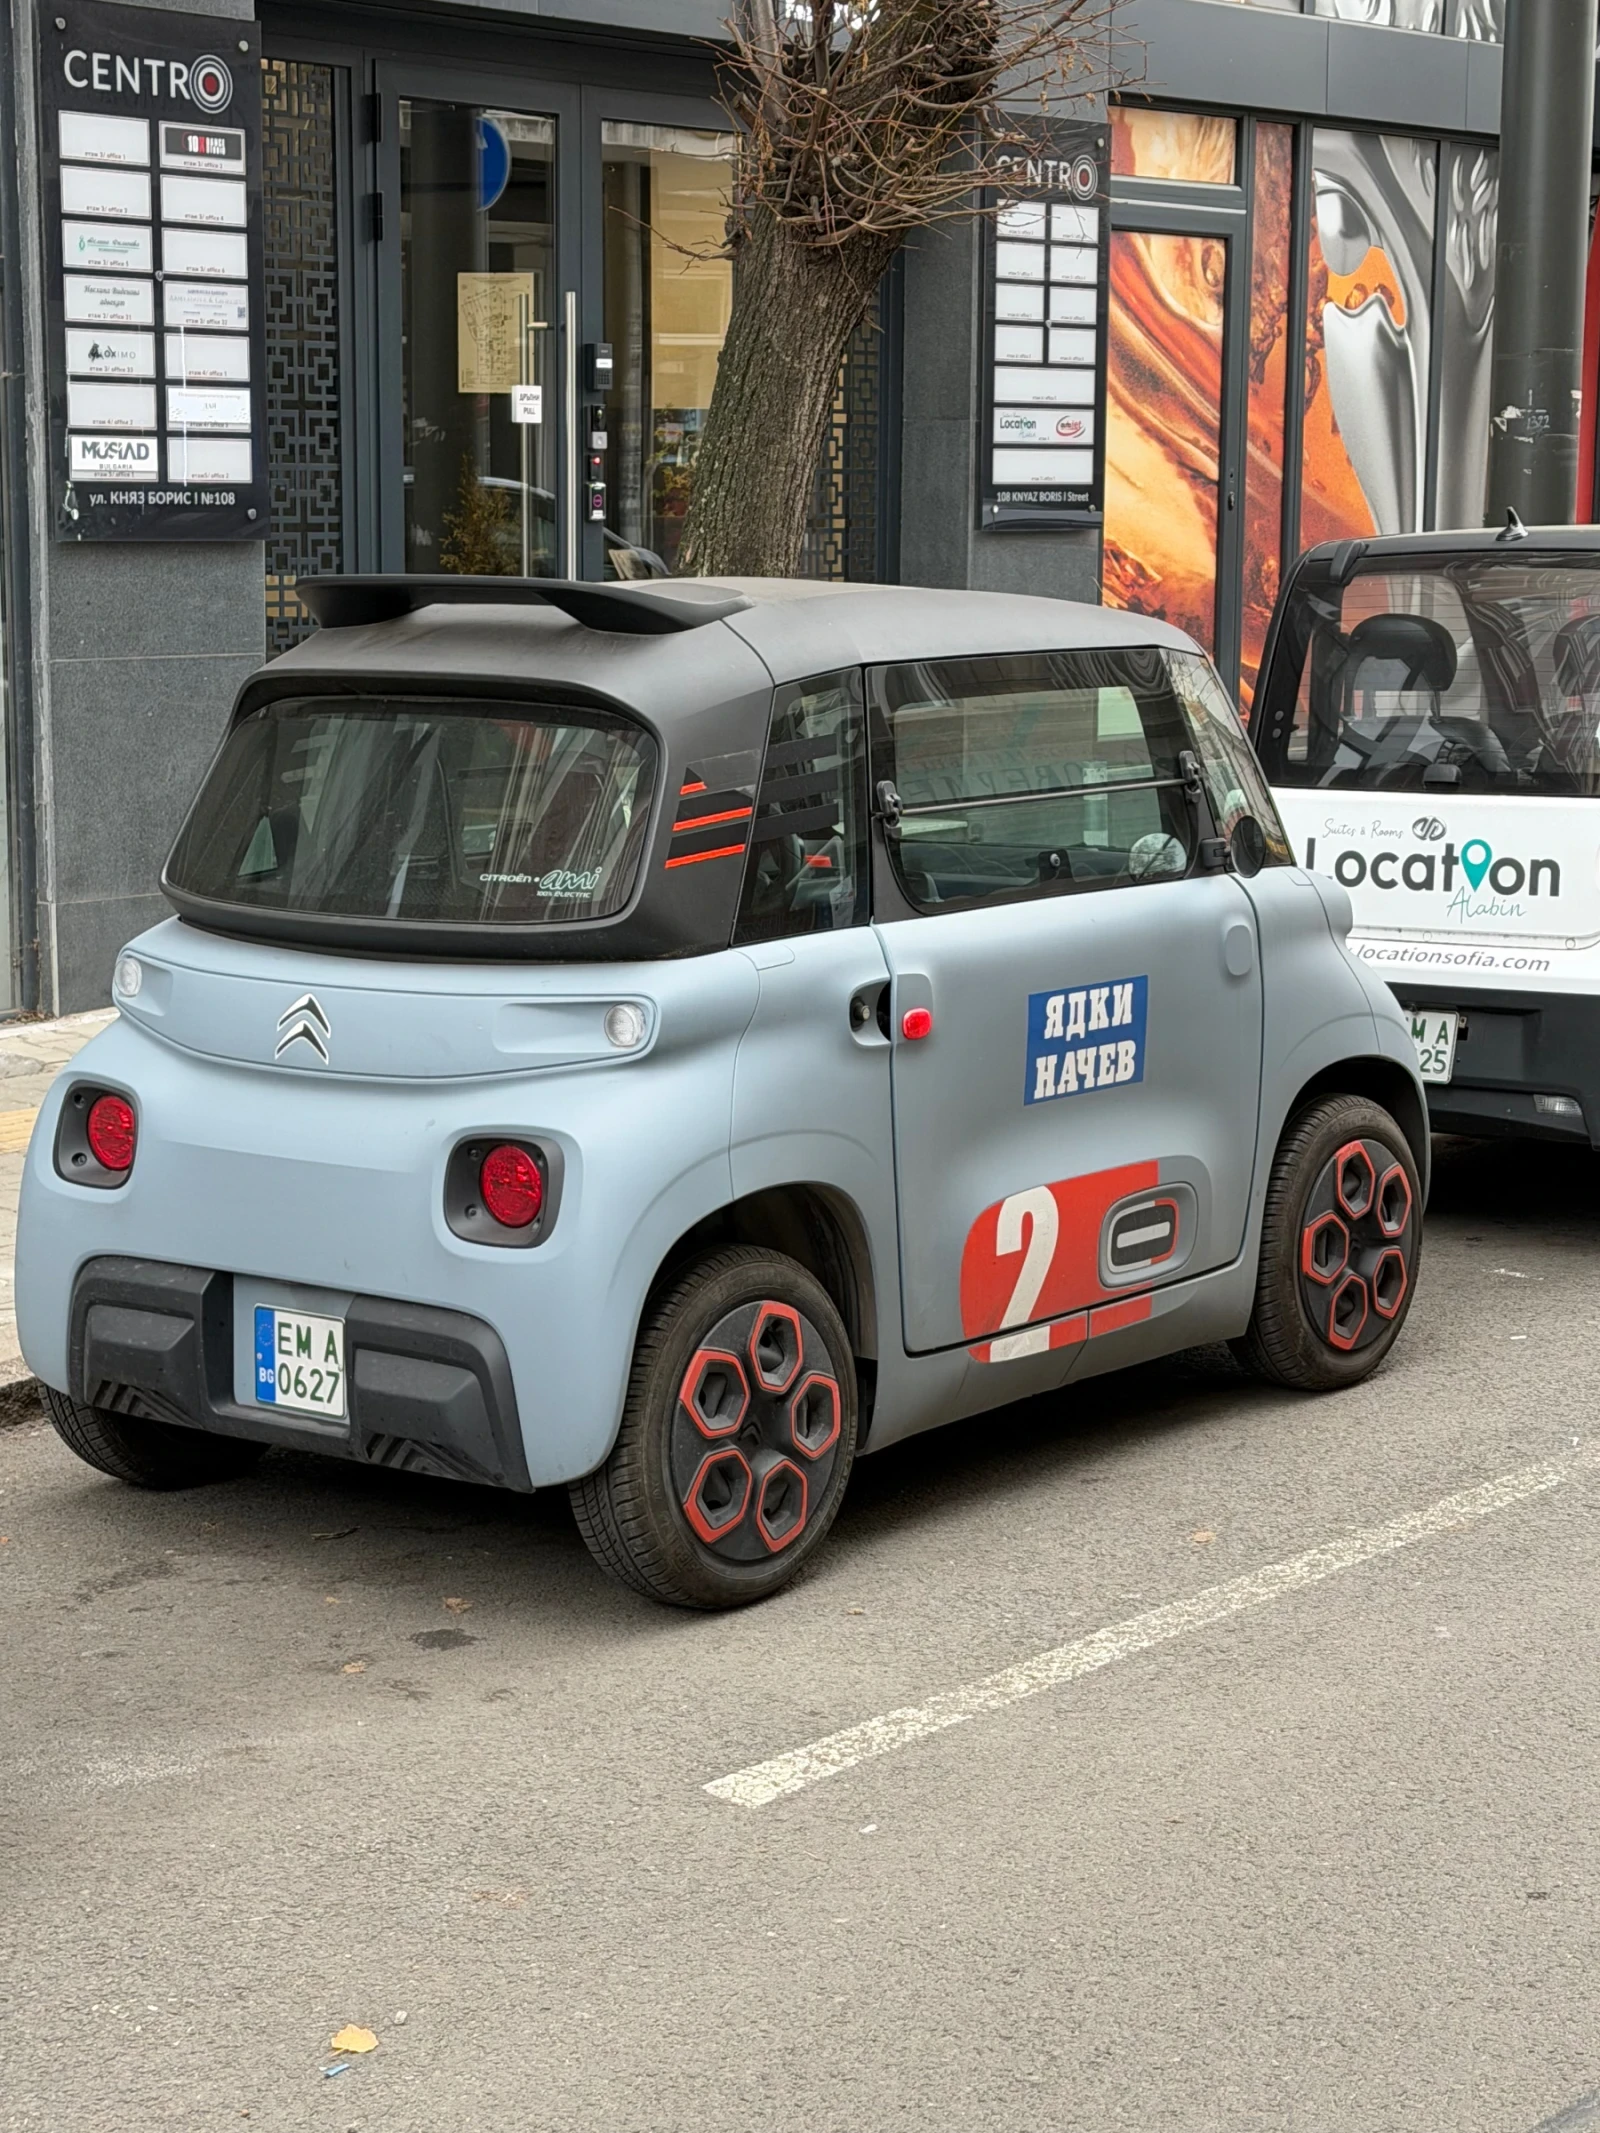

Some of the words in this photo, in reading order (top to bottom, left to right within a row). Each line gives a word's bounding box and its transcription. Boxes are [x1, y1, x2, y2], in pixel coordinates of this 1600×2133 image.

[64, 49, 234, 115] CENTRO
[89, 493, 107, 507] ул.
[110, 491, 145, 506] КНЯЗ
[148, 491, 191, 505] БОРИС
[201, 491, 236, 506] №108
[997, 491, 1011, 502] 108
[1012, 491, 1038, 502] KNYAZ
[1040, 491, 1062, 502] BORIS
[1067, 491, 1089, 502] Street
[1322, 817, 1357, 839] Suites
[1370, 819, 1404, 840] Rooms
[539, 866, 603, 891] ami
[1446, 885, 1527, 925] Alabin
[1043, 982, 1134, 1041] ЯДКИ
[1435, 1020, 1449, 1045] A
[1033, 1039, 1136, 1101] НАЧЕВ
[1419, 1048, 1448, 1074] 25
[277, 1321, 312, 1360] EM
[324, 1329, 339, 1365] A
[259, 1367, 275, 1384] BG
[277, 1362, 340, 1404] 0627
